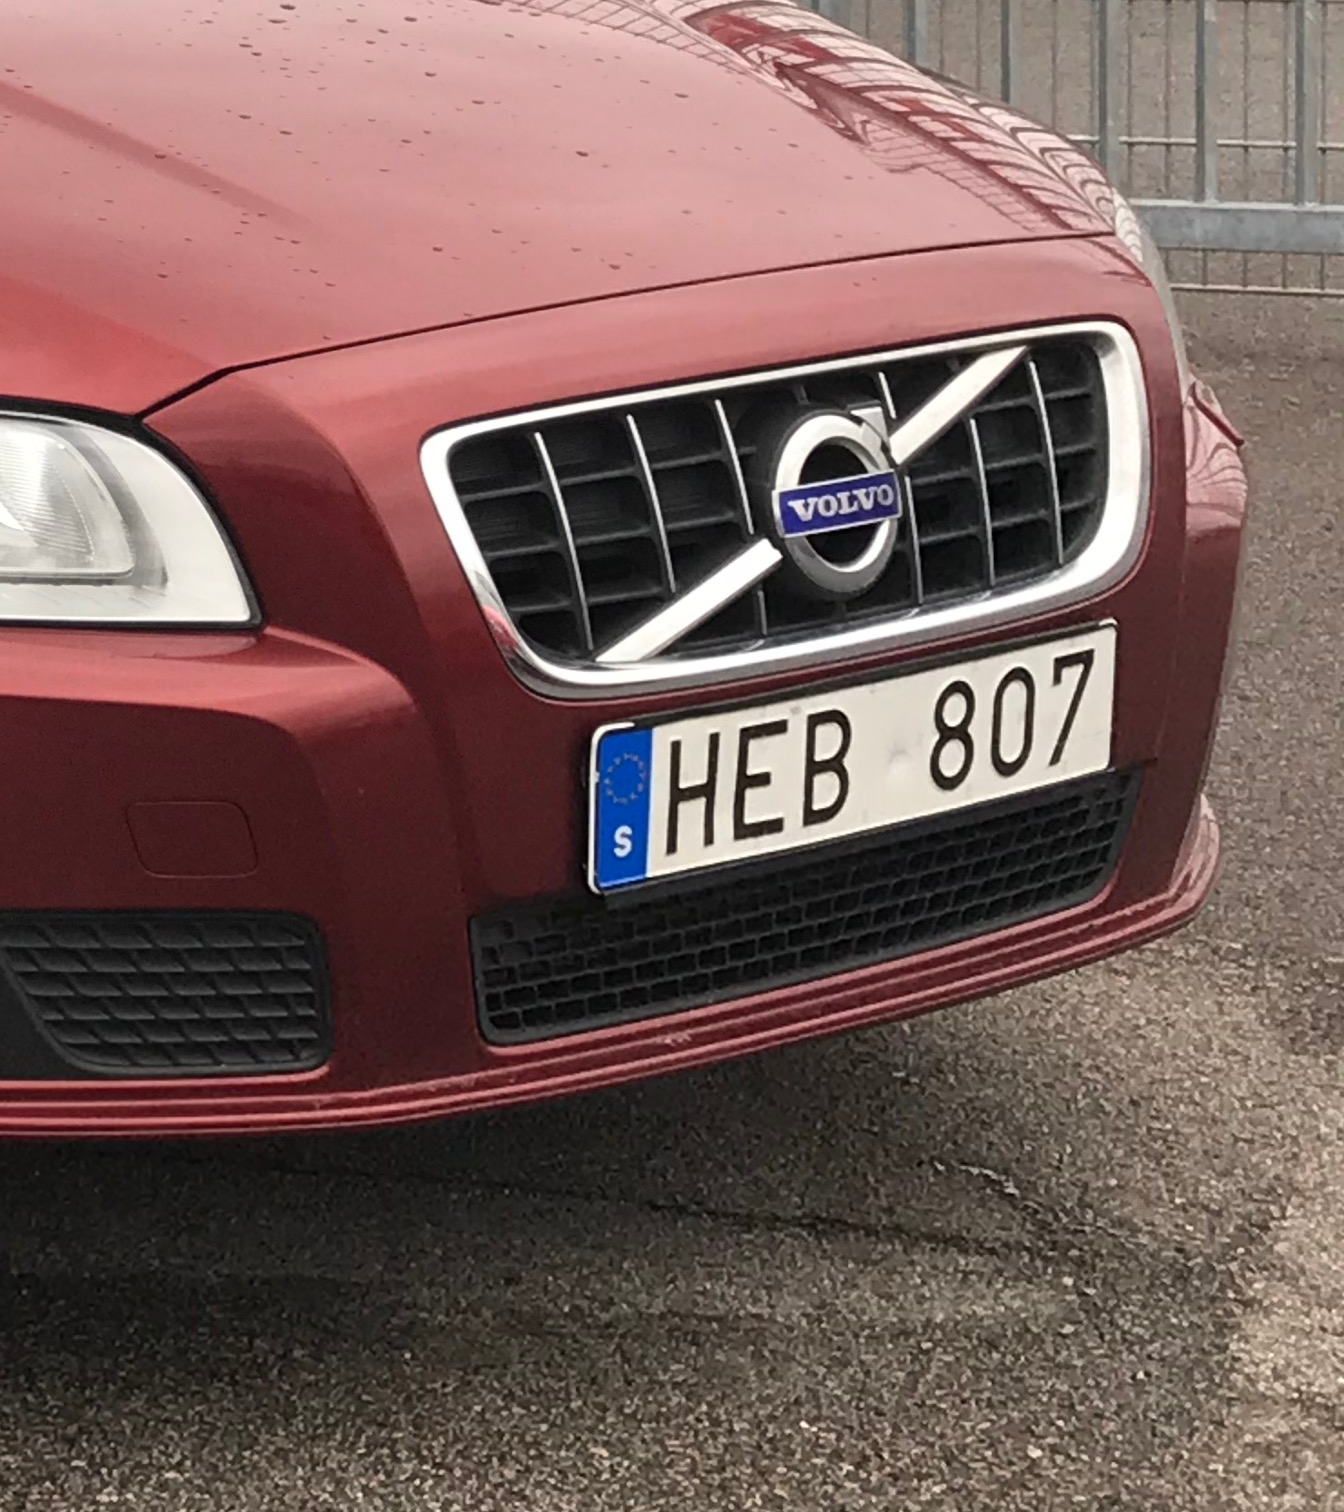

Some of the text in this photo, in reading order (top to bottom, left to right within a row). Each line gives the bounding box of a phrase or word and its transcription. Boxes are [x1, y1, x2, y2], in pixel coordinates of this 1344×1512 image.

[788, 485, 894, 521] VOLVO
[666, 648, 1095, 855] HEB 807
[613, 826, 633, 857] S
